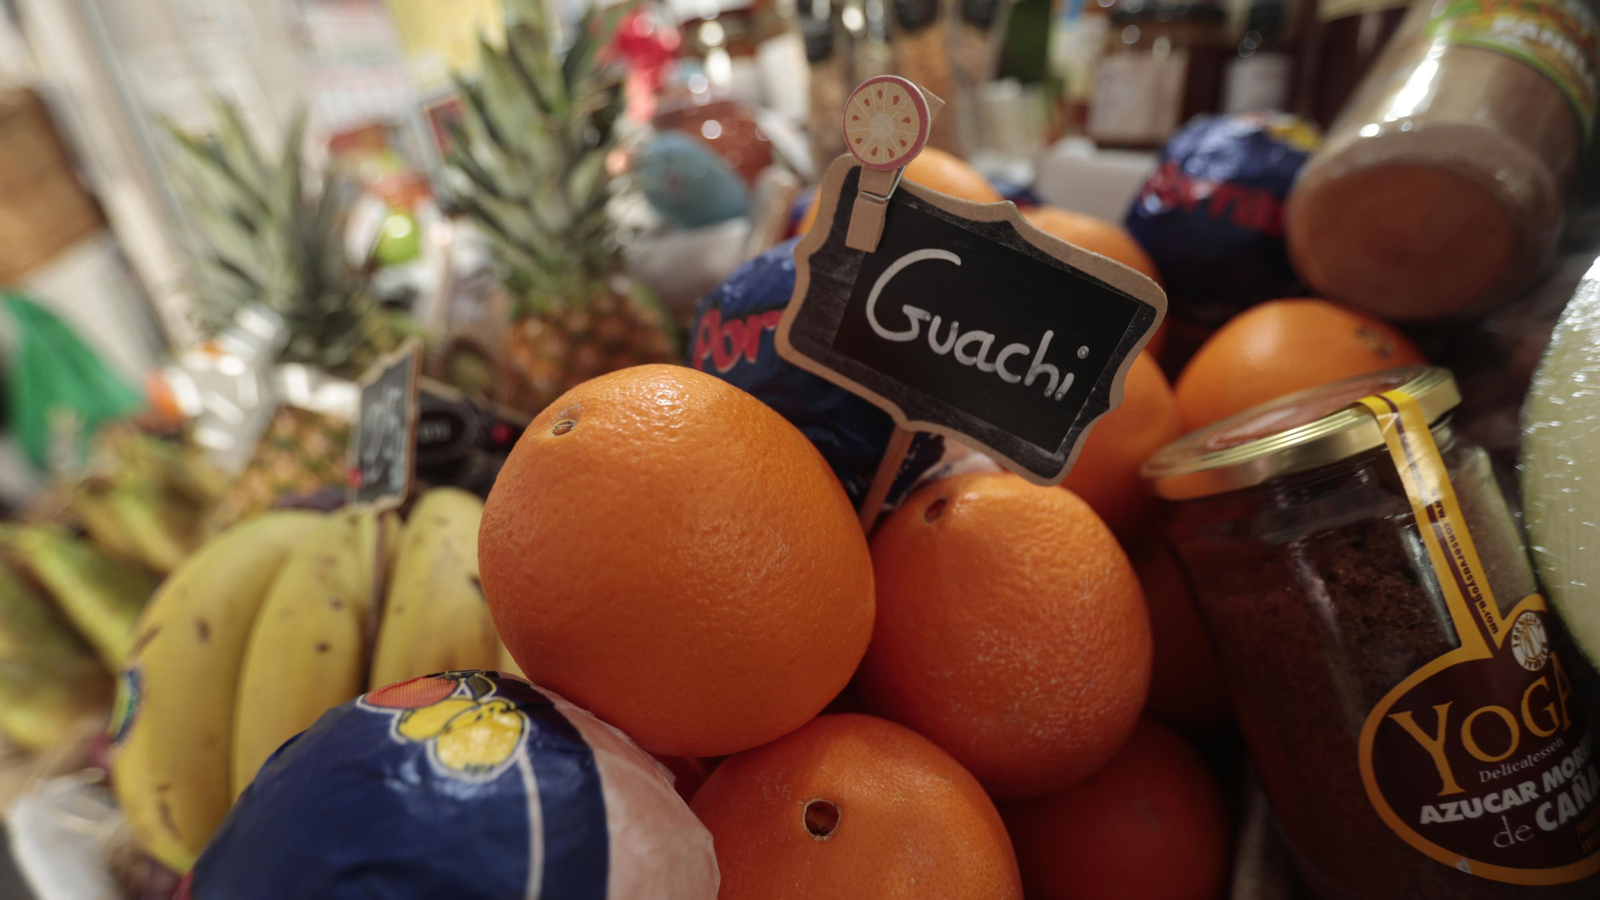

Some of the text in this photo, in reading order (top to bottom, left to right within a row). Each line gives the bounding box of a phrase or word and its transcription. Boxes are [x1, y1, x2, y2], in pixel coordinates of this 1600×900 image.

[693, 308, 787, 373] Por
[866, 248, 1089, 400] Guachi
[1387, 651, 1576, 796] YOGA
[1479, 737, 1564, 783] Delicatessen
[1419, 780, 1540, 825] AZUCAR
[1493, 815, 1534, 848] de
